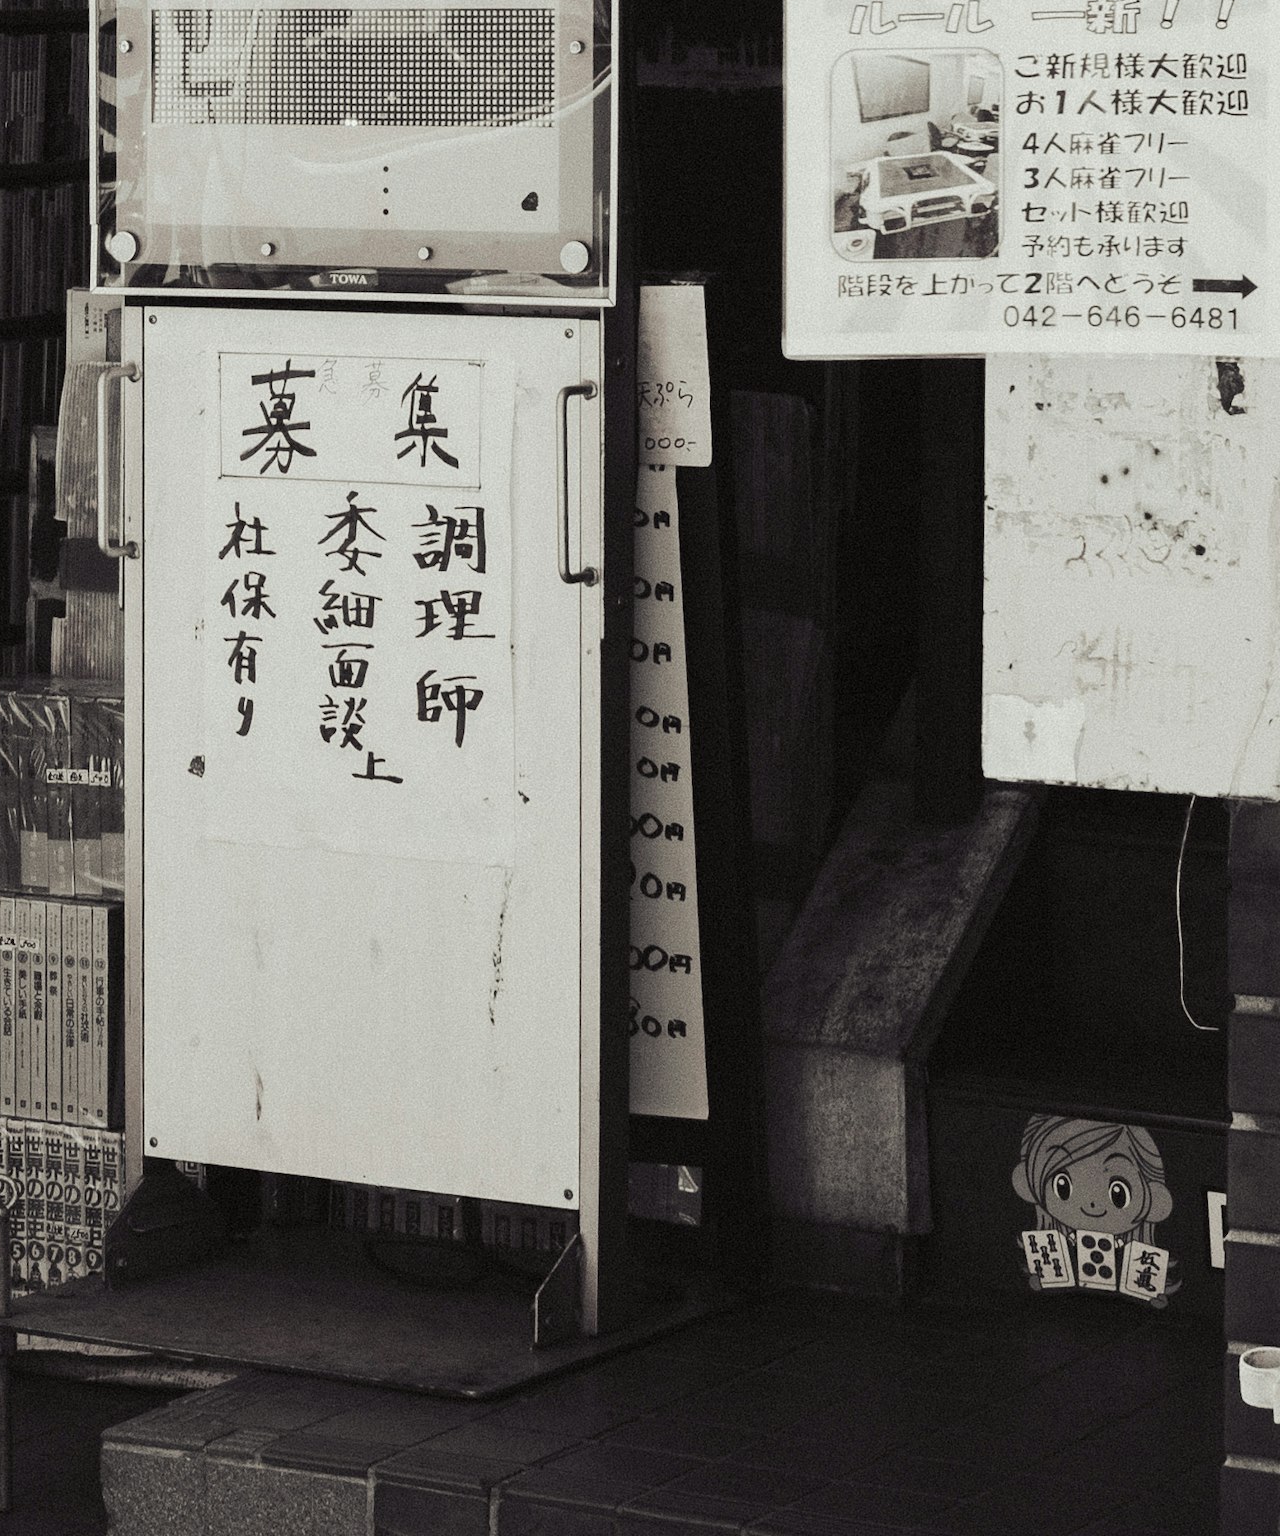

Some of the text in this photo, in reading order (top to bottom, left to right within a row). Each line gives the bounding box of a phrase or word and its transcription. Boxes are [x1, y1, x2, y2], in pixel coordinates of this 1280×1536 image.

[1014, 52, 1247, 80] ご新規様大歓迎
[1016, 89, 1248, 116] お1人様大歓迎
[1022, 131, 1189, 155] 4人麻雀フリー
[1023, 167, 1190, 190] 3人麻雀フリー
[1022, 200, 1189, 223] セット様歓迎
[1022, 235, 1189, 258] 予約も承ります
[329, 273, 368, 285] TOWA
[838, 272, 1181, 298] 階段を上がって2階へどうぞ
[410, 504, 495, 747] 調理師
[26, 1135, 44, 1240] 世界の歴史
